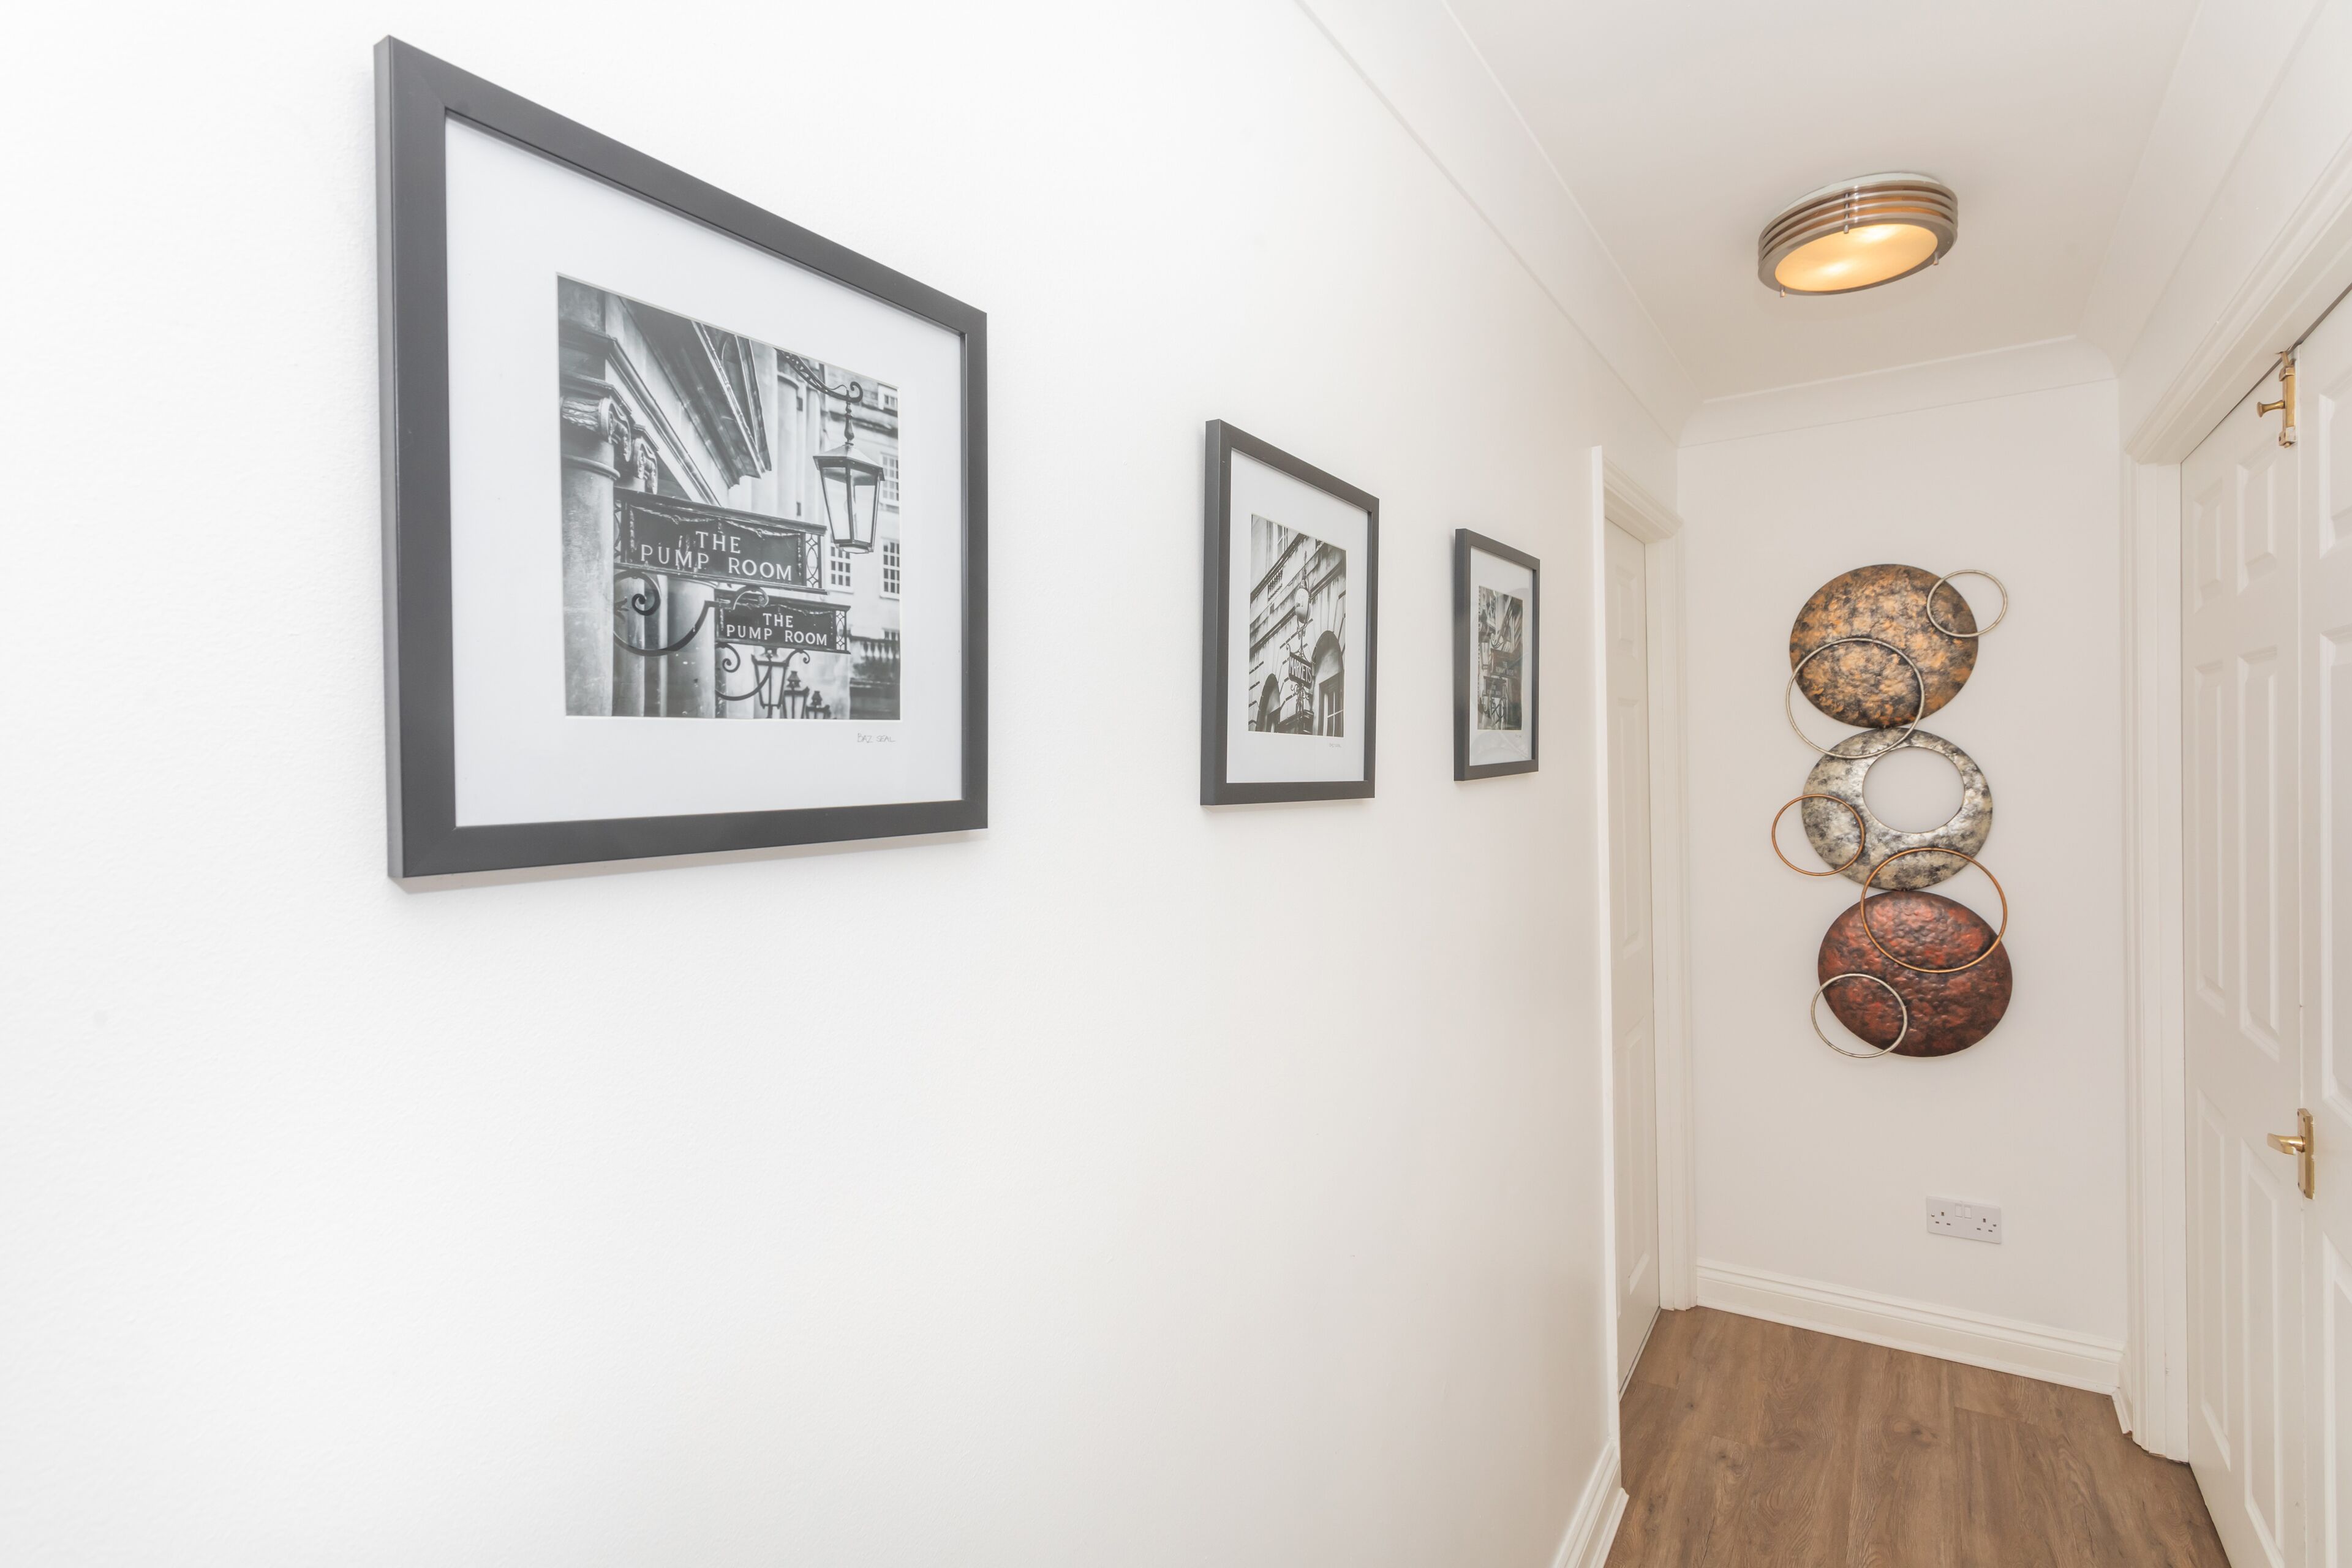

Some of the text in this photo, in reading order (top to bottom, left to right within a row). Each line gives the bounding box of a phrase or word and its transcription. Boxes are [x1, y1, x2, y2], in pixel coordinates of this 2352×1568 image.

[696, 531, 741, 554] THE
[641, 544, 792, 581] PUMP ROOM
[763, 613, 794, 628] THE
[726, 624, 827, 646] PUMP ROOM
[1290, 657, 1312, 684] MARKETS
